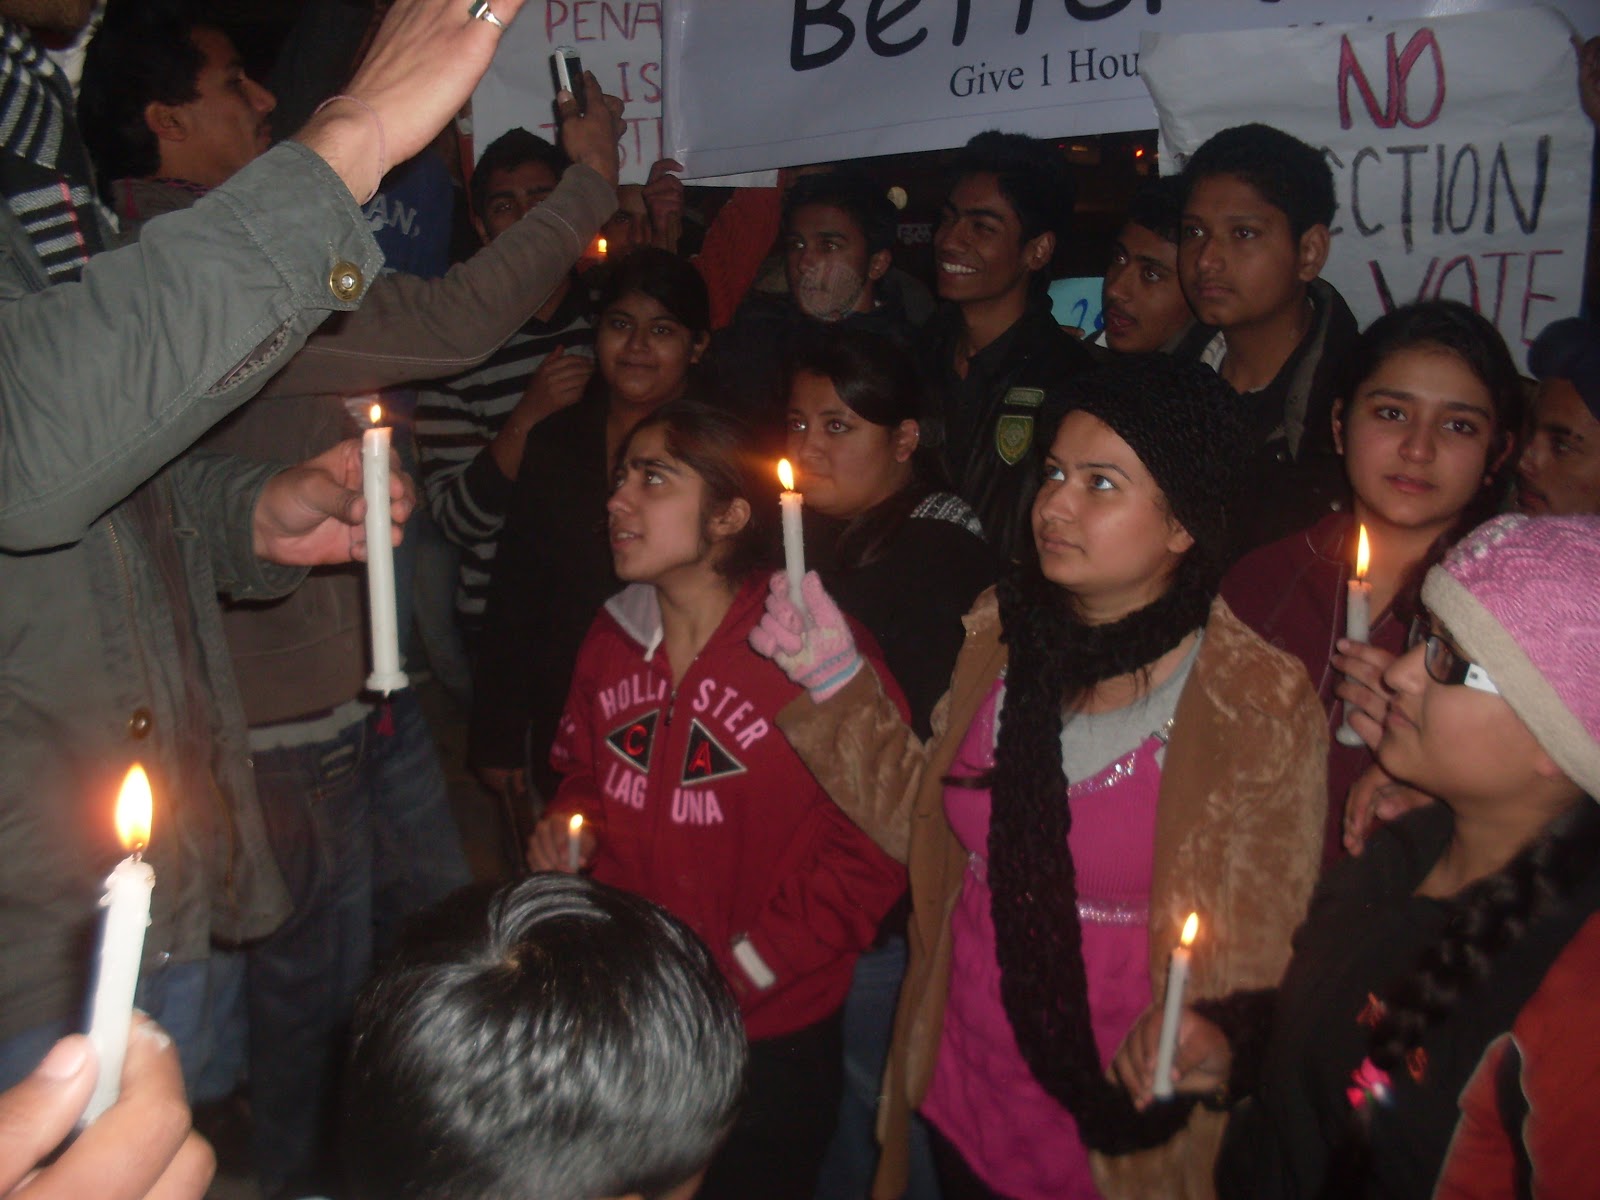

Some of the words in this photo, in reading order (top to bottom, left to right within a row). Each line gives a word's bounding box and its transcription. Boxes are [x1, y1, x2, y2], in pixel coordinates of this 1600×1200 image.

[617, 62, 664, 104] IS
[949, 62, 1024, 98] Give
[1041, 53, 1051, 87] 1
[1337, 27, 1445, 130] NO
